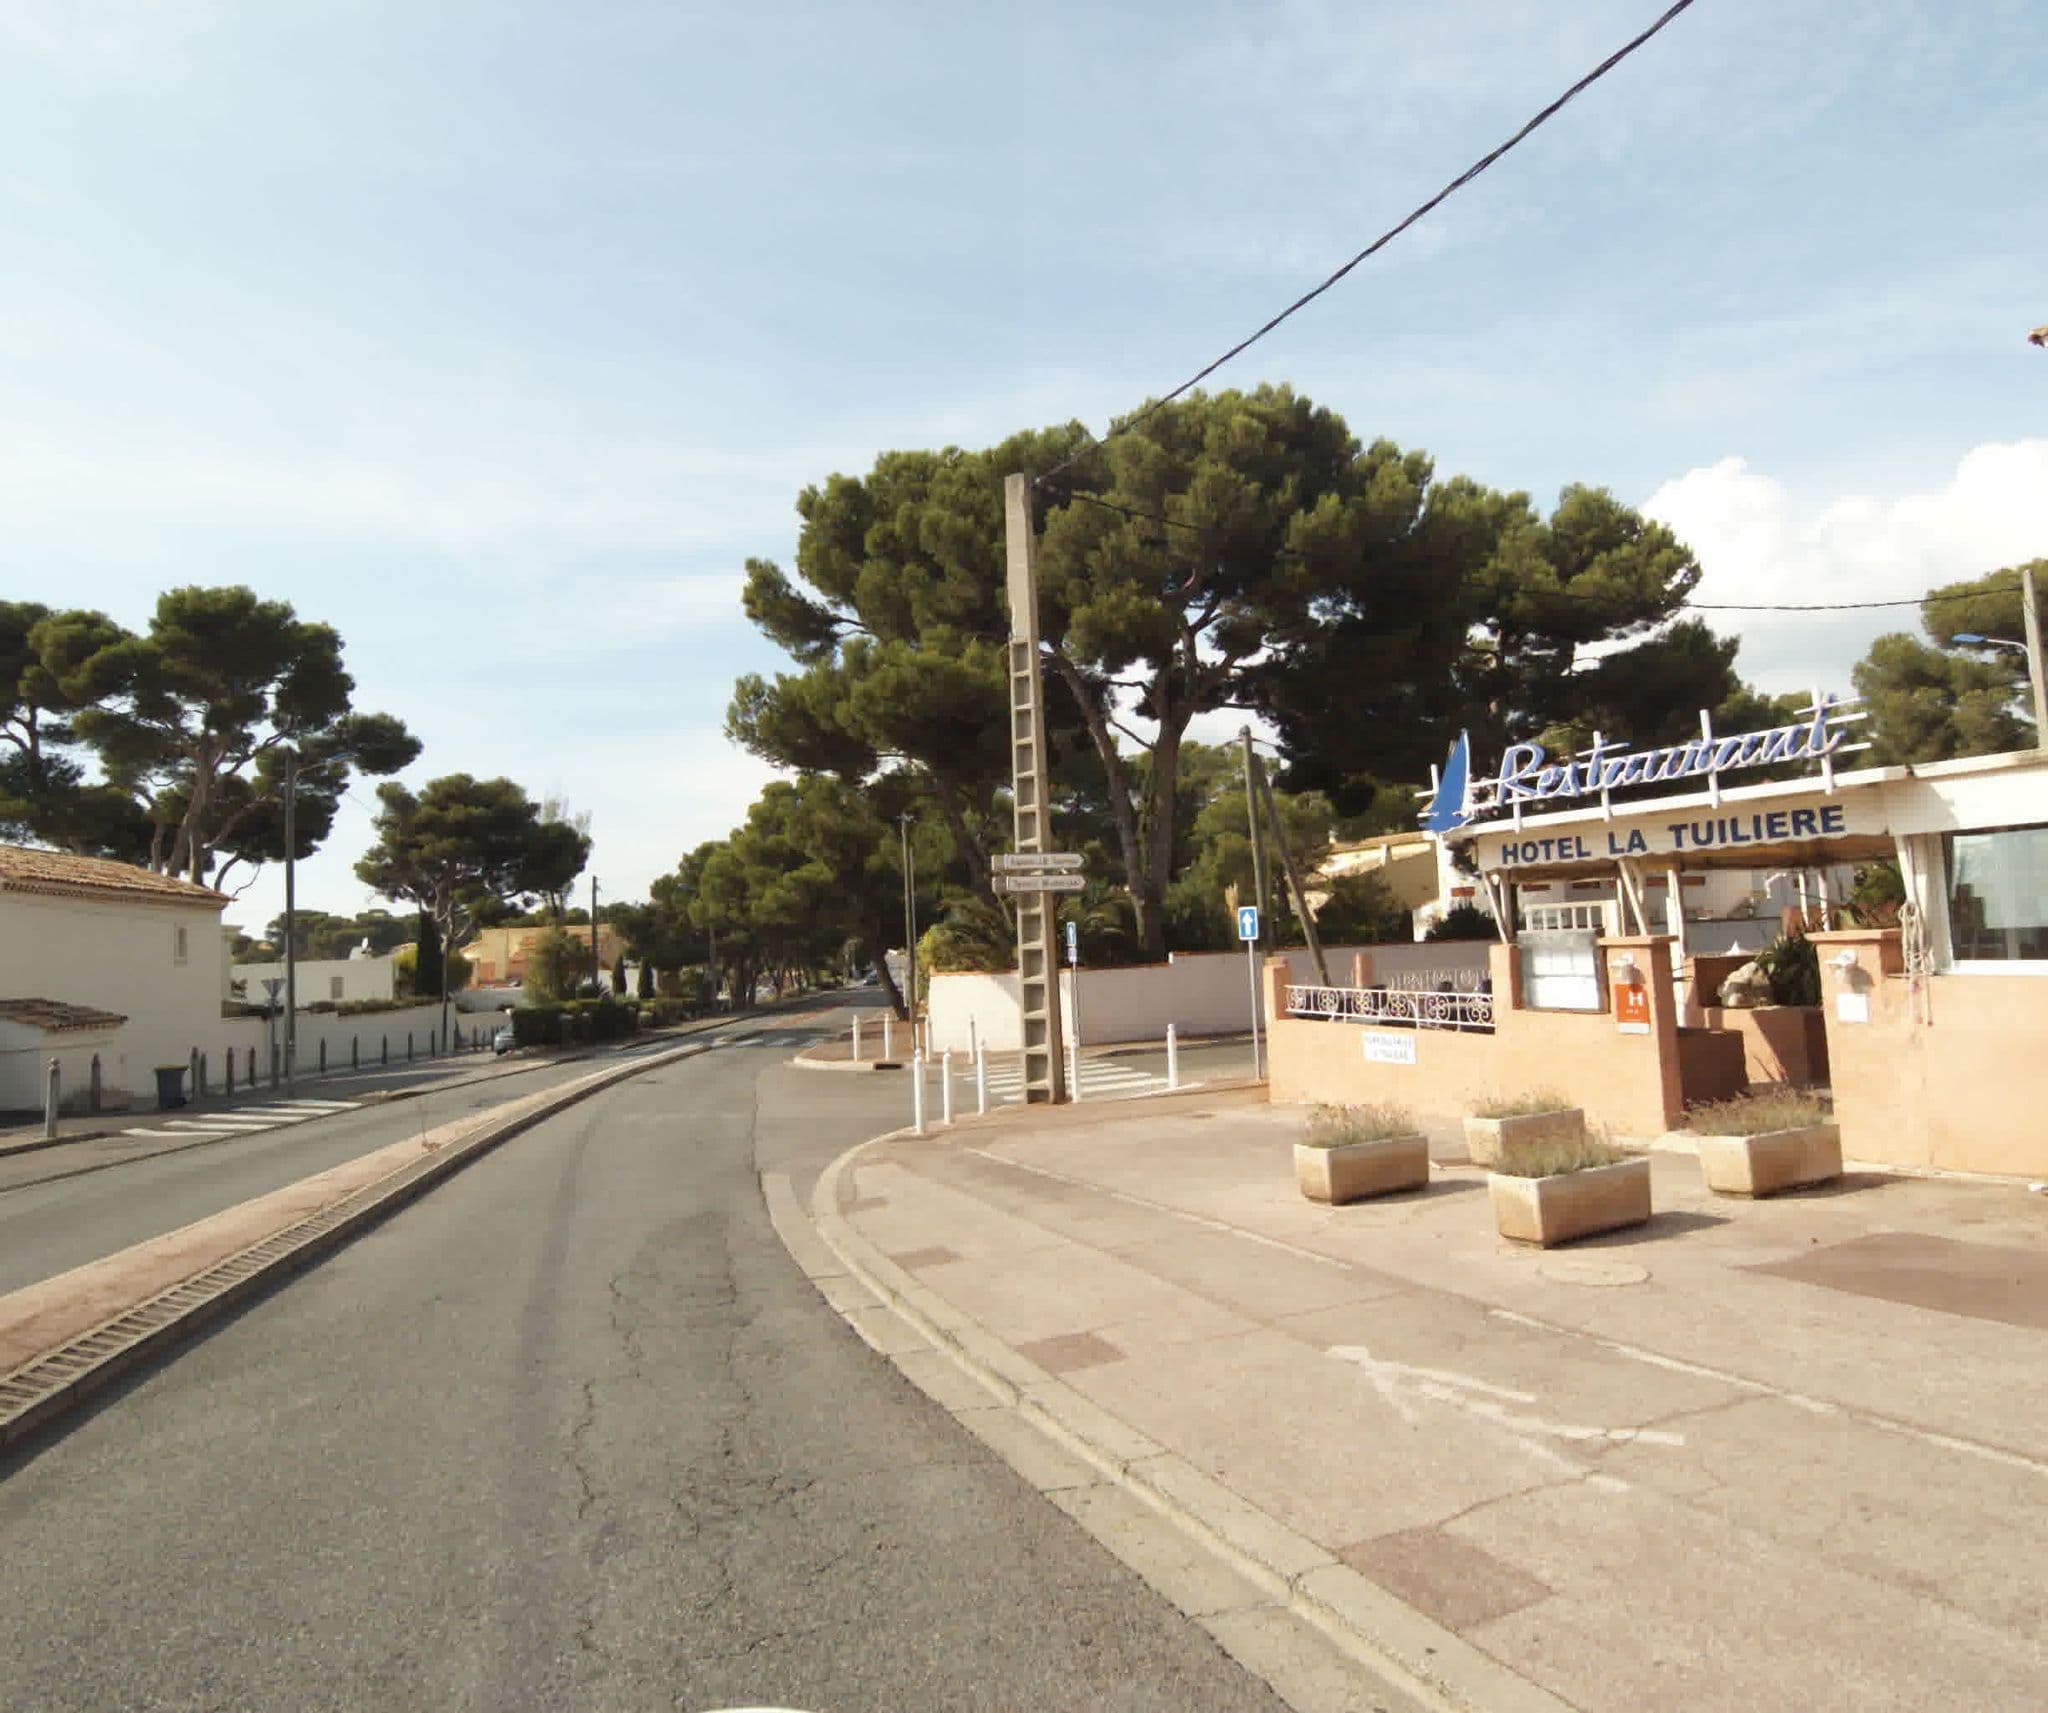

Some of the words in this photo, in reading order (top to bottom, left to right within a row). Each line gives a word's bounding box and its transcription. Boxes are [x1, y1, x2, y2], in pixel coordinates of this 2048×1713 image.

[1497, 693, 1846, 806] Restaurant
[1501, 835, 1592, 865] HOTEL
[1608, 828, 1648, 855] LA
[1668, 804, 1846, 848] TUILIERE
